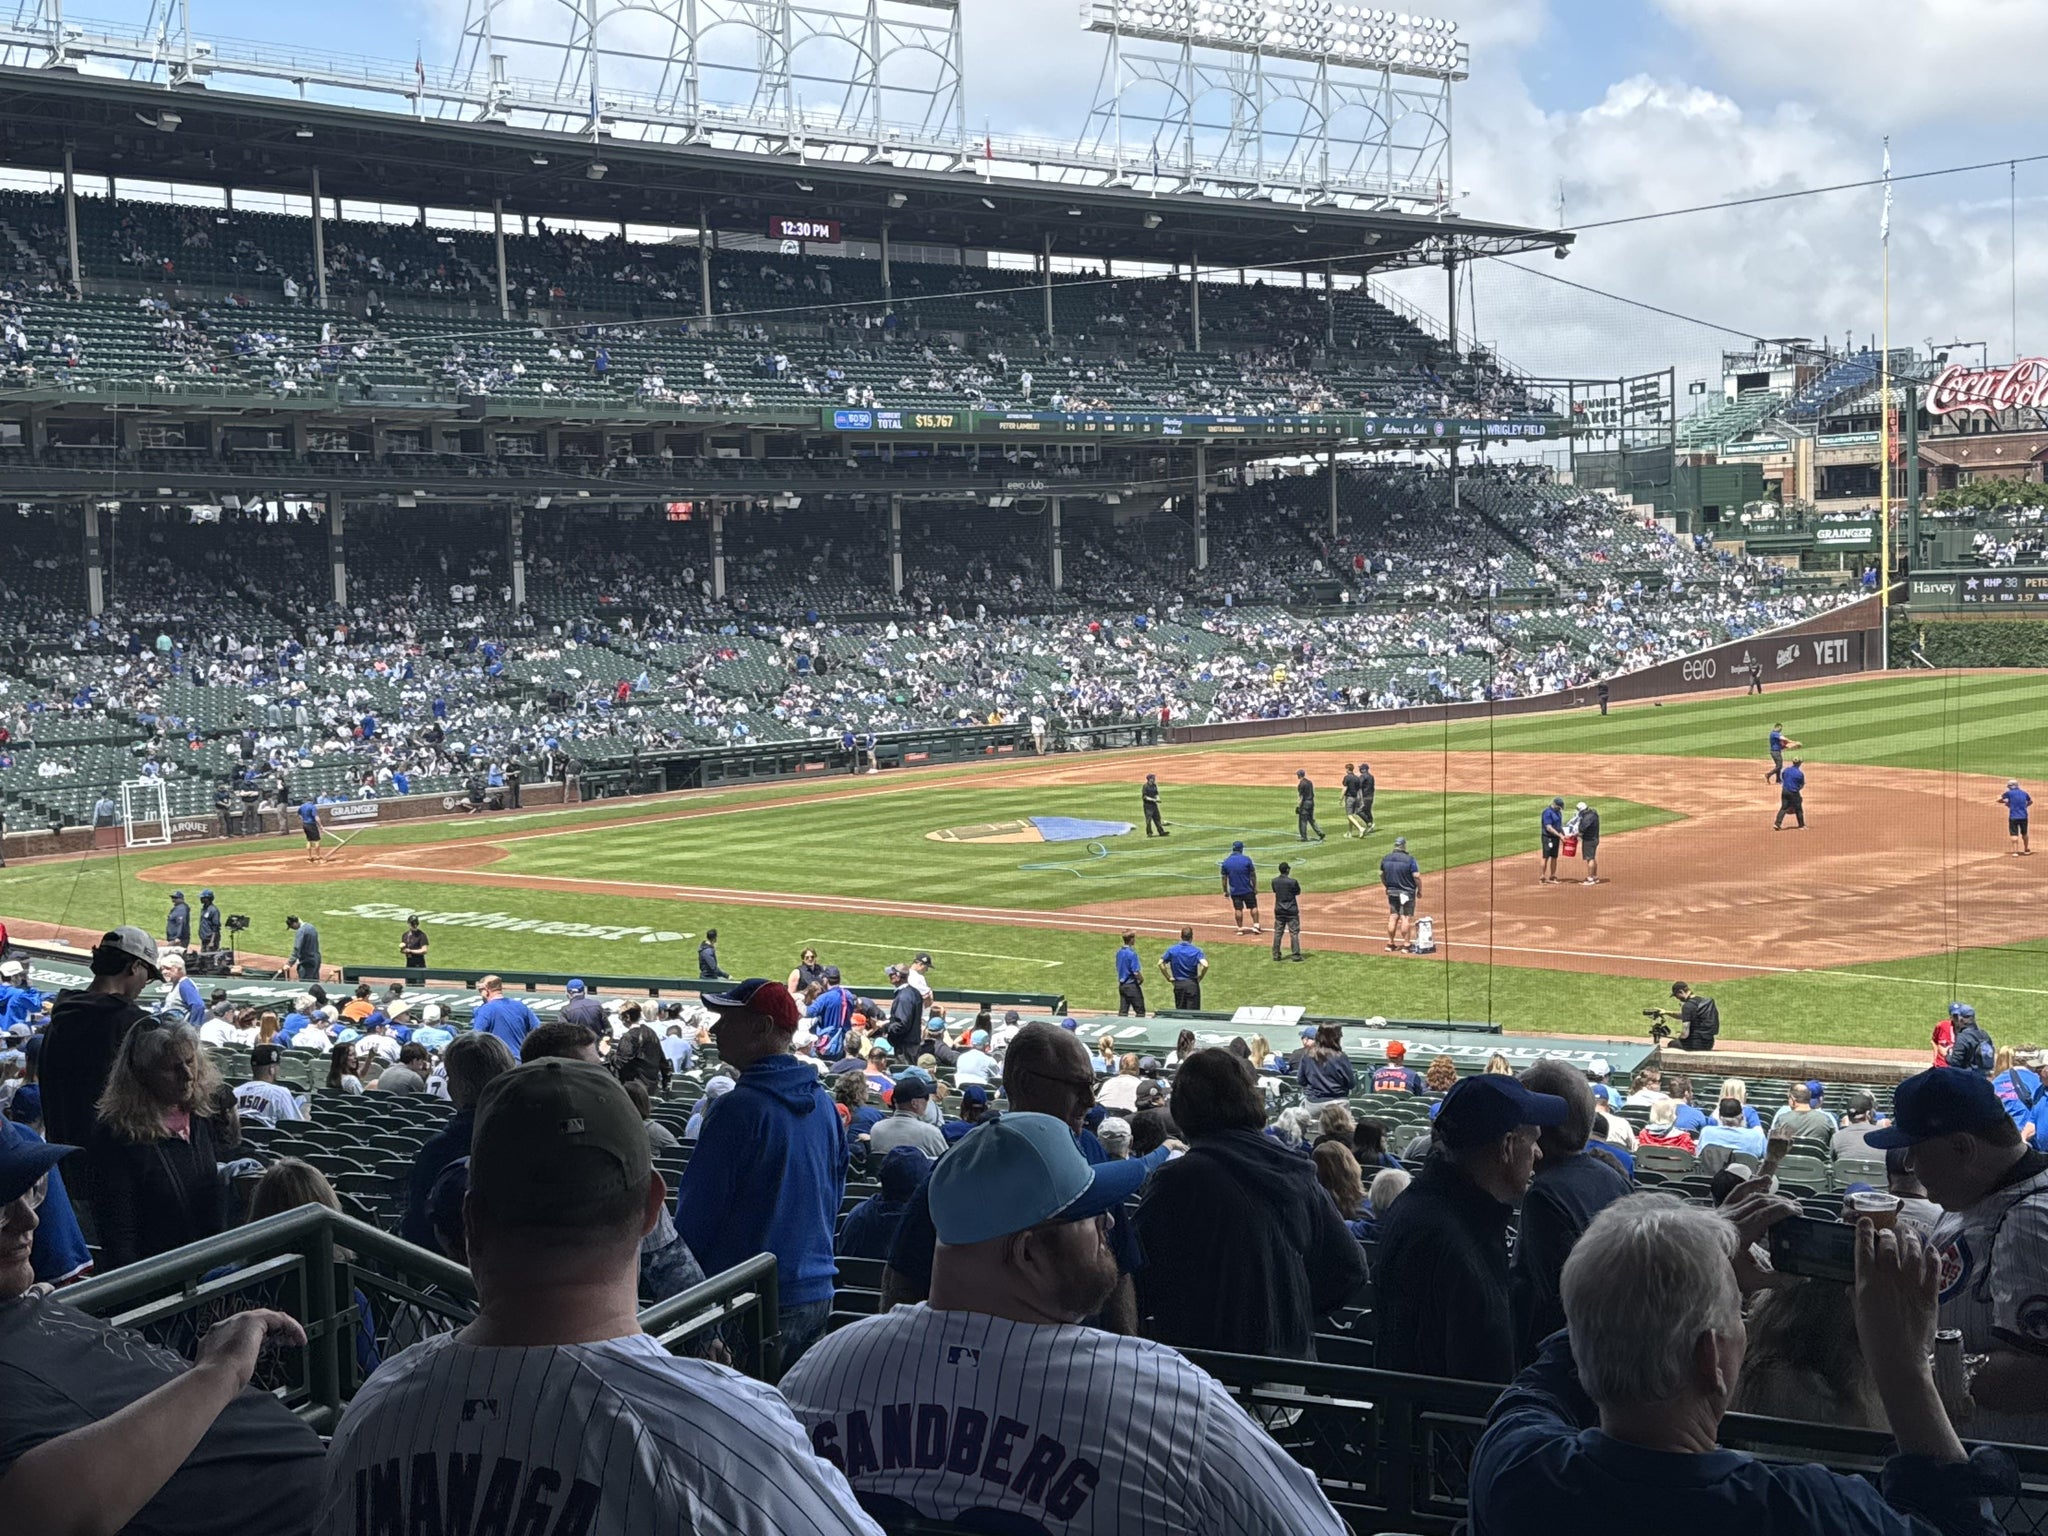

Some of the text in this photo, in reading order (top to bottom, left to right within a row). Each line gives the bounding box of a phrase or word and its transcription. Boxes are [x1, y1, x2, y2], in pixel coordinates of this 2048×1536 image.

[781, 221, 829, 238] 12:30 PM
[877, 419, 902, 429] TOTAL
[916, 414, 953, 428] $15,767
[1382, 423, 1402, 435] Astros
[1413, 423, 1427, 435] Cubs
[1487, 424, 1546, 436] WRIGLEY FIELD
[1817, 528, 1872, 539] GRAINGER
[1913, 581, 1956, 595] Harvey
[1984, 578, 2003, 588] RHP
[2004, 577, 2018, 588] 38
[1981, 594, 1994, 602] 2-4
[2001, 593, 2014, 601] ERA
[2017, 593, 2035, 602] 3.57
[1813, 638, 1848, 665] YETI
[1682, 657, 1717, 682] eero
[330, 804, 378, 817] GRAINGER
[431, 1081, 441, 1095] 7
[812, 1403, 1100, 1522] SANDBERG
[355, 1452, 602, 1536] IMANAGA
